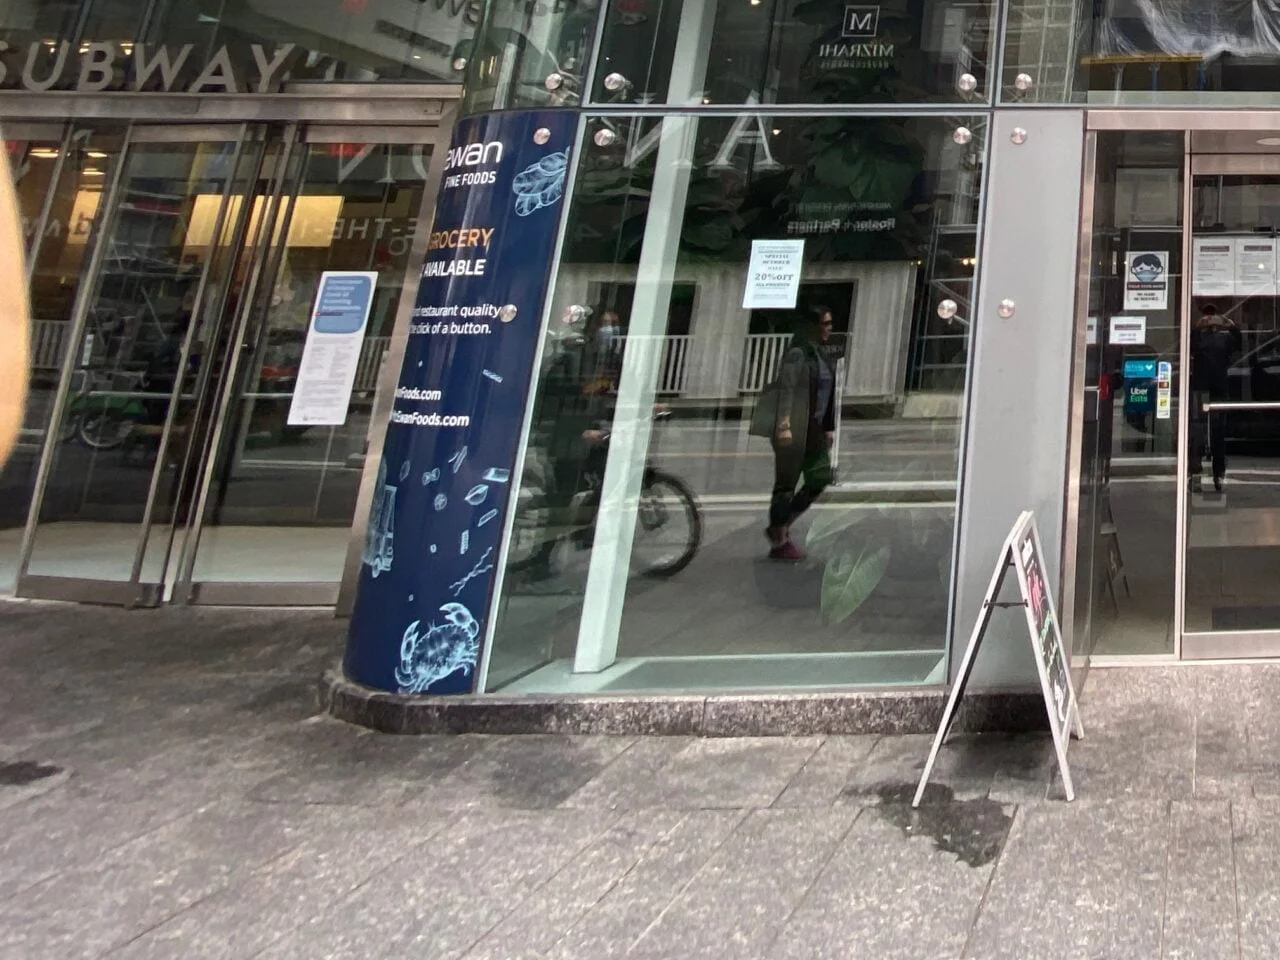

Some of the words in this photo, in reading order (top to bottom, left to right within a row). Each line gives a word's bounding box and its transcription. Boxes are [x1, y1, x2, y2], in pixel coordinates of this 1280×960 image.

[461, 171, 497, 186] FOODS
[424, 259, 486, 277] AVAILABLE
[460, 304, 501, 318] quality
[450, 322, 492, 334] button.
